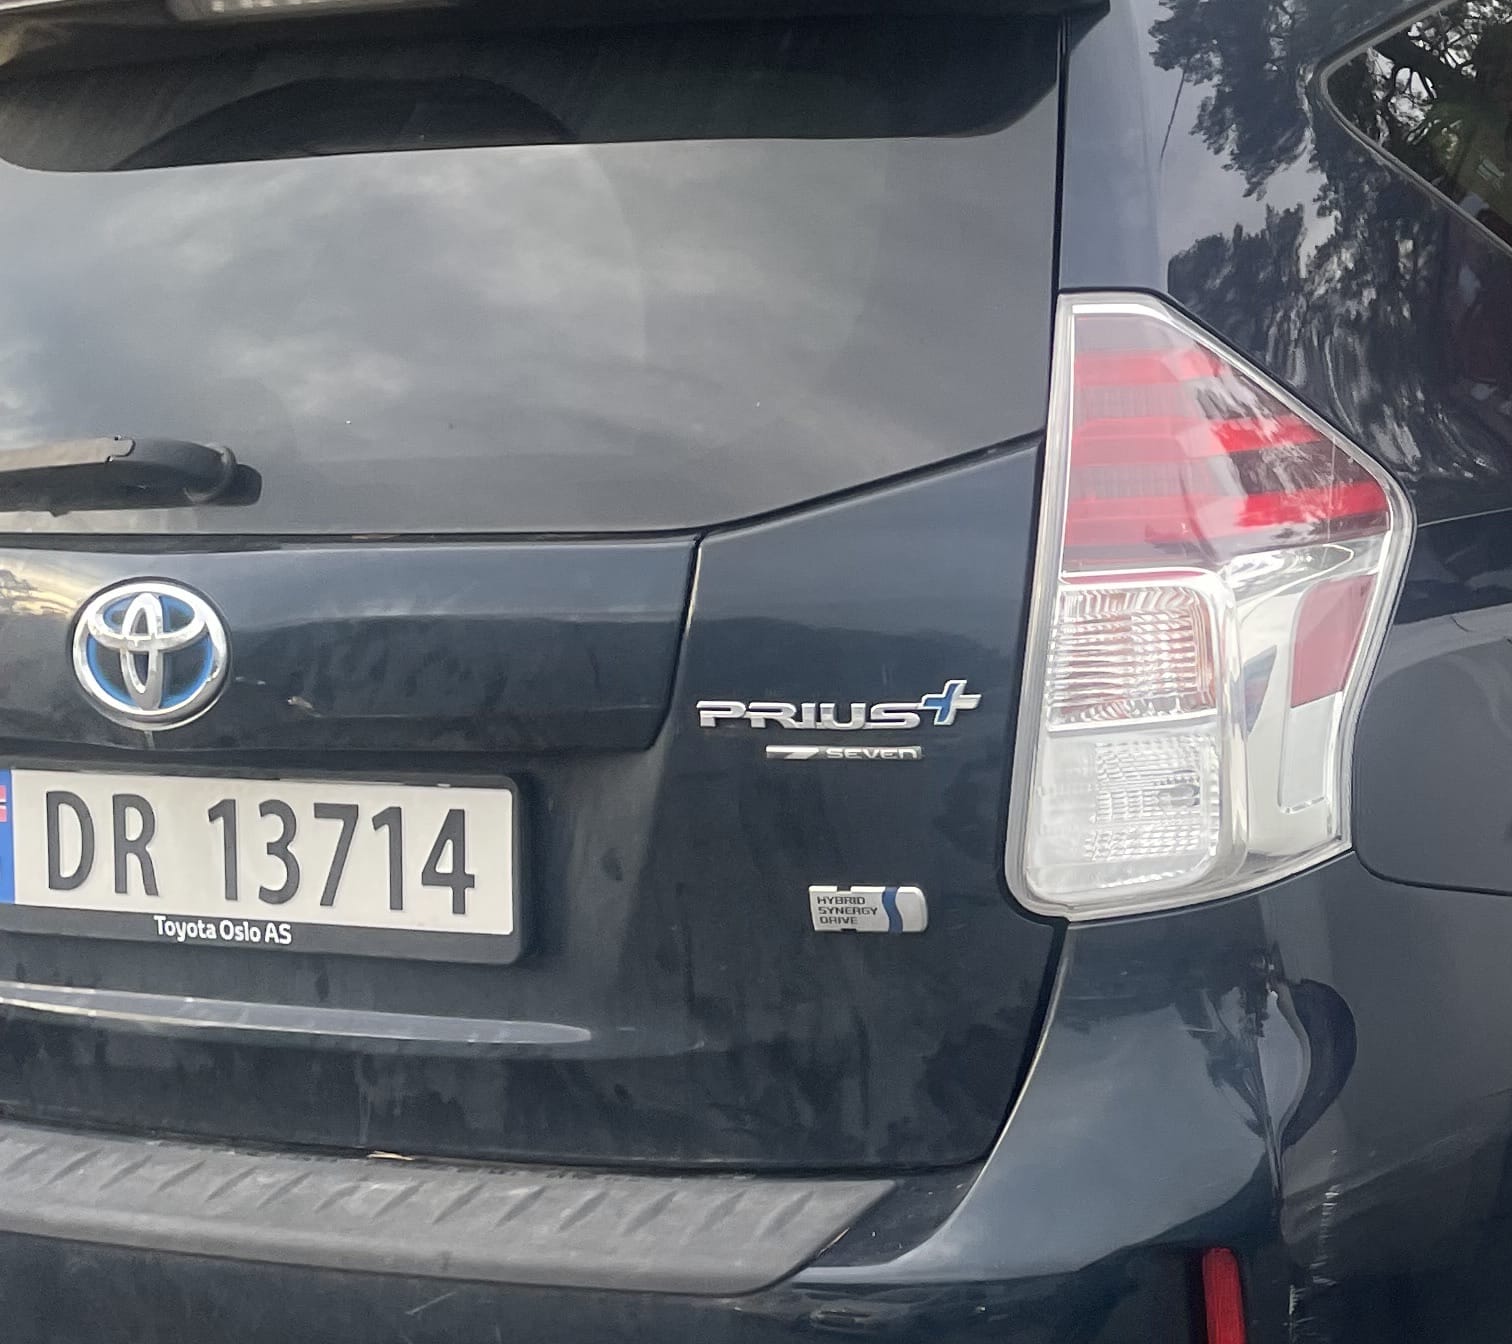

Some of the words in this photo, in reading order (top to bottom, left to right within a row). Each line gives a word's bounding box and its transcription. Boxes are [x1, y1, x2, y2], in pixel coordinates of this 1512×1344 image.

[826, 748, 918, 759] SEVEN
[46, 790, 159, 896] DR
[208, 798, 475, 915] 13714
[816, 896, 866, 905] HYBRID
[818, 906, 878, 916] SYNERGY
[819, 916, 859, 925] DRIVE
[153, 915, 217, 942] Toyota
[219, 919, 261, 942] Oslo
[264, 922, 293, 945] AS
